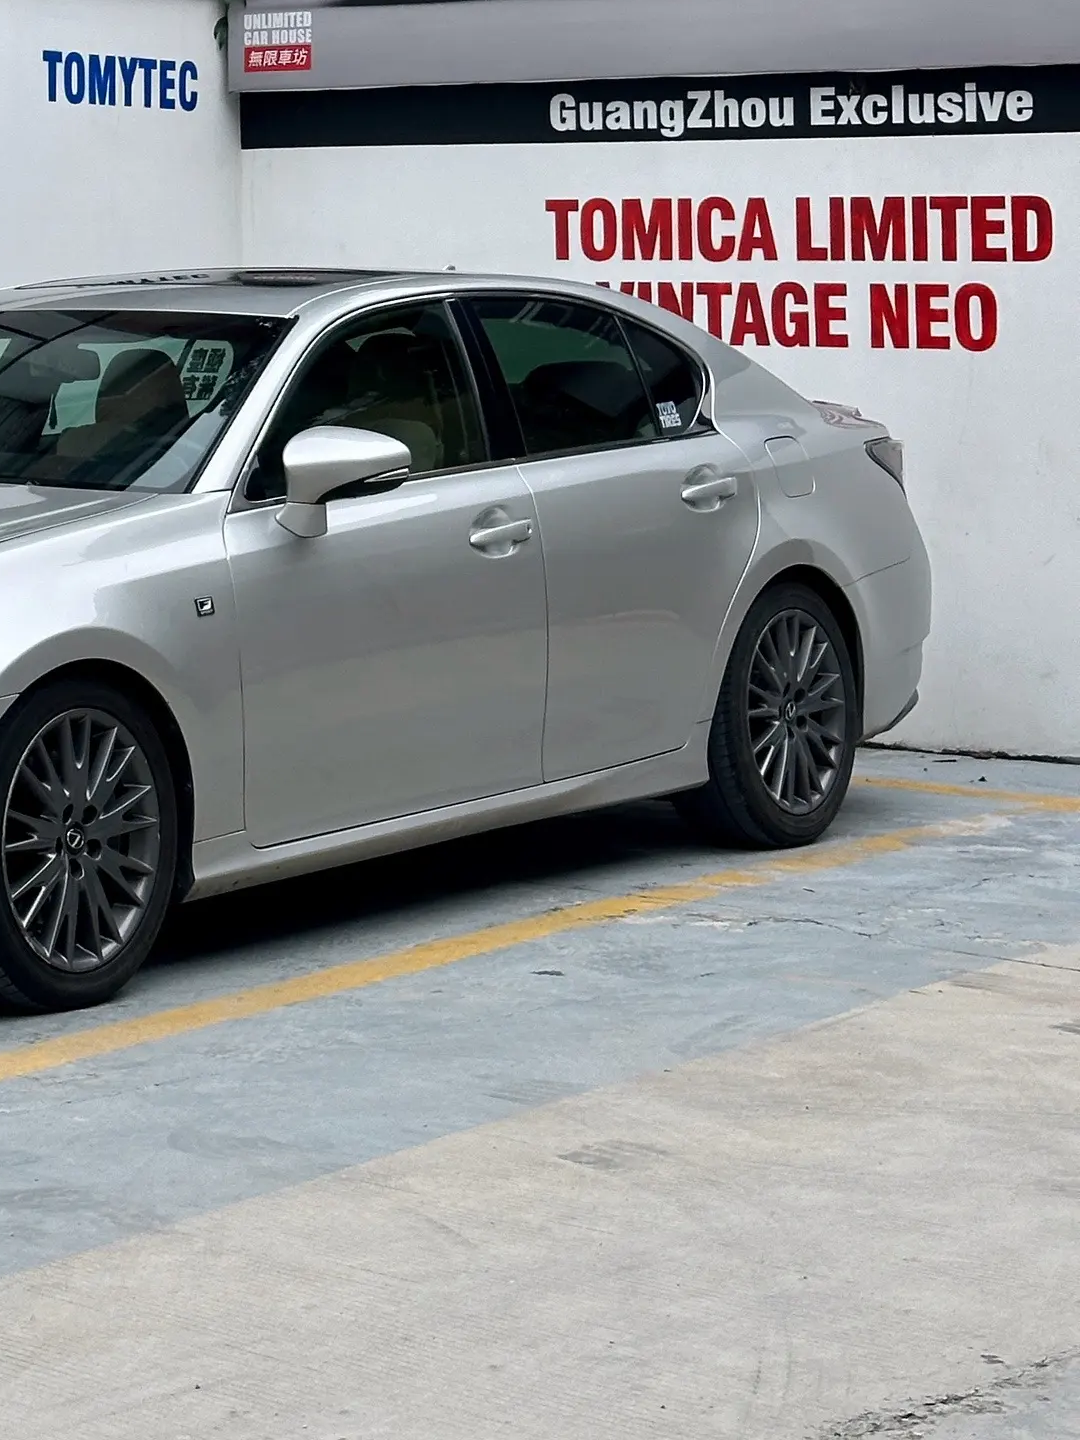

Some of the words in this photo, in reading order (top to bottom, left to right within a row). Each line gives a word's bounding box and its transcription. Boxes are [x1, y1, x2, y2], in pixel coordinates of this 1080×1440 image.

[244, 11, 312, 29] UNLIMITED
[244, 30, 268, 46] CAR
[271, 28, 312, 45] HOUSE
[42, 50, 198, 111] TOMYTEC
[248, 48, 308, 67] 無限車坊
[550, 90, 795, 137] GuangZhou
[810, 83, 1033, 127] Exclusive
[545, 197, 777, 262] TOMICA
[796, 196, 1053, 262] LIMITED
[595, 281, 848, 348] NTAGE
[870, 282, 997, 351] NEO
